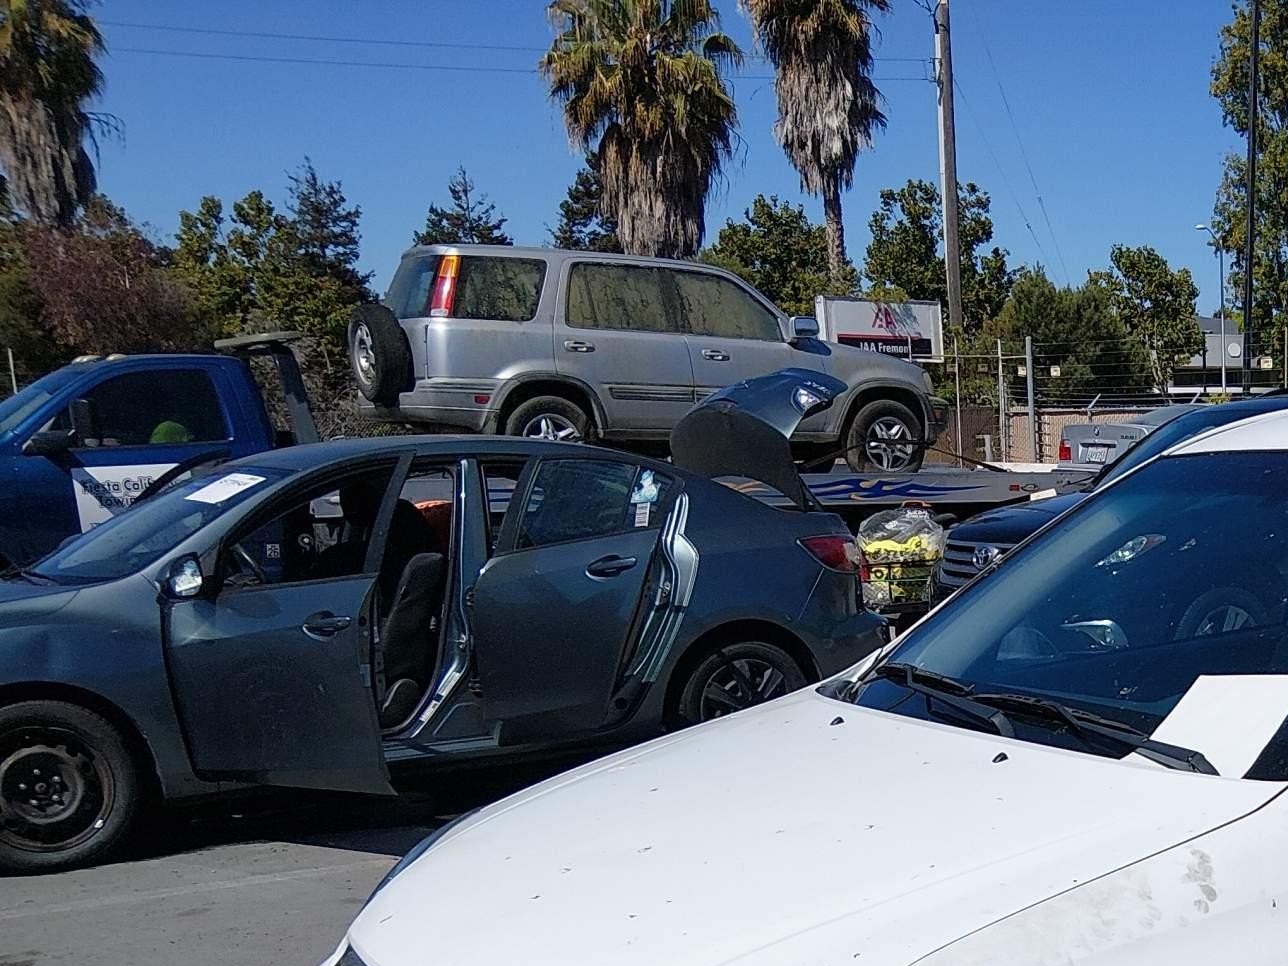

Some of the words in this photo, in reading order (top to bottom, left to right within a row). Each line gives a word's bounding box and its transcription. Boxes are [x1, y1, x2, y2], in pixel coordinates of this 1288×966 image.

[859, 341, 876, 352] IAA
[82, 479, 120, 494] Fiesta
[96, 496, 138, 508] Towin
